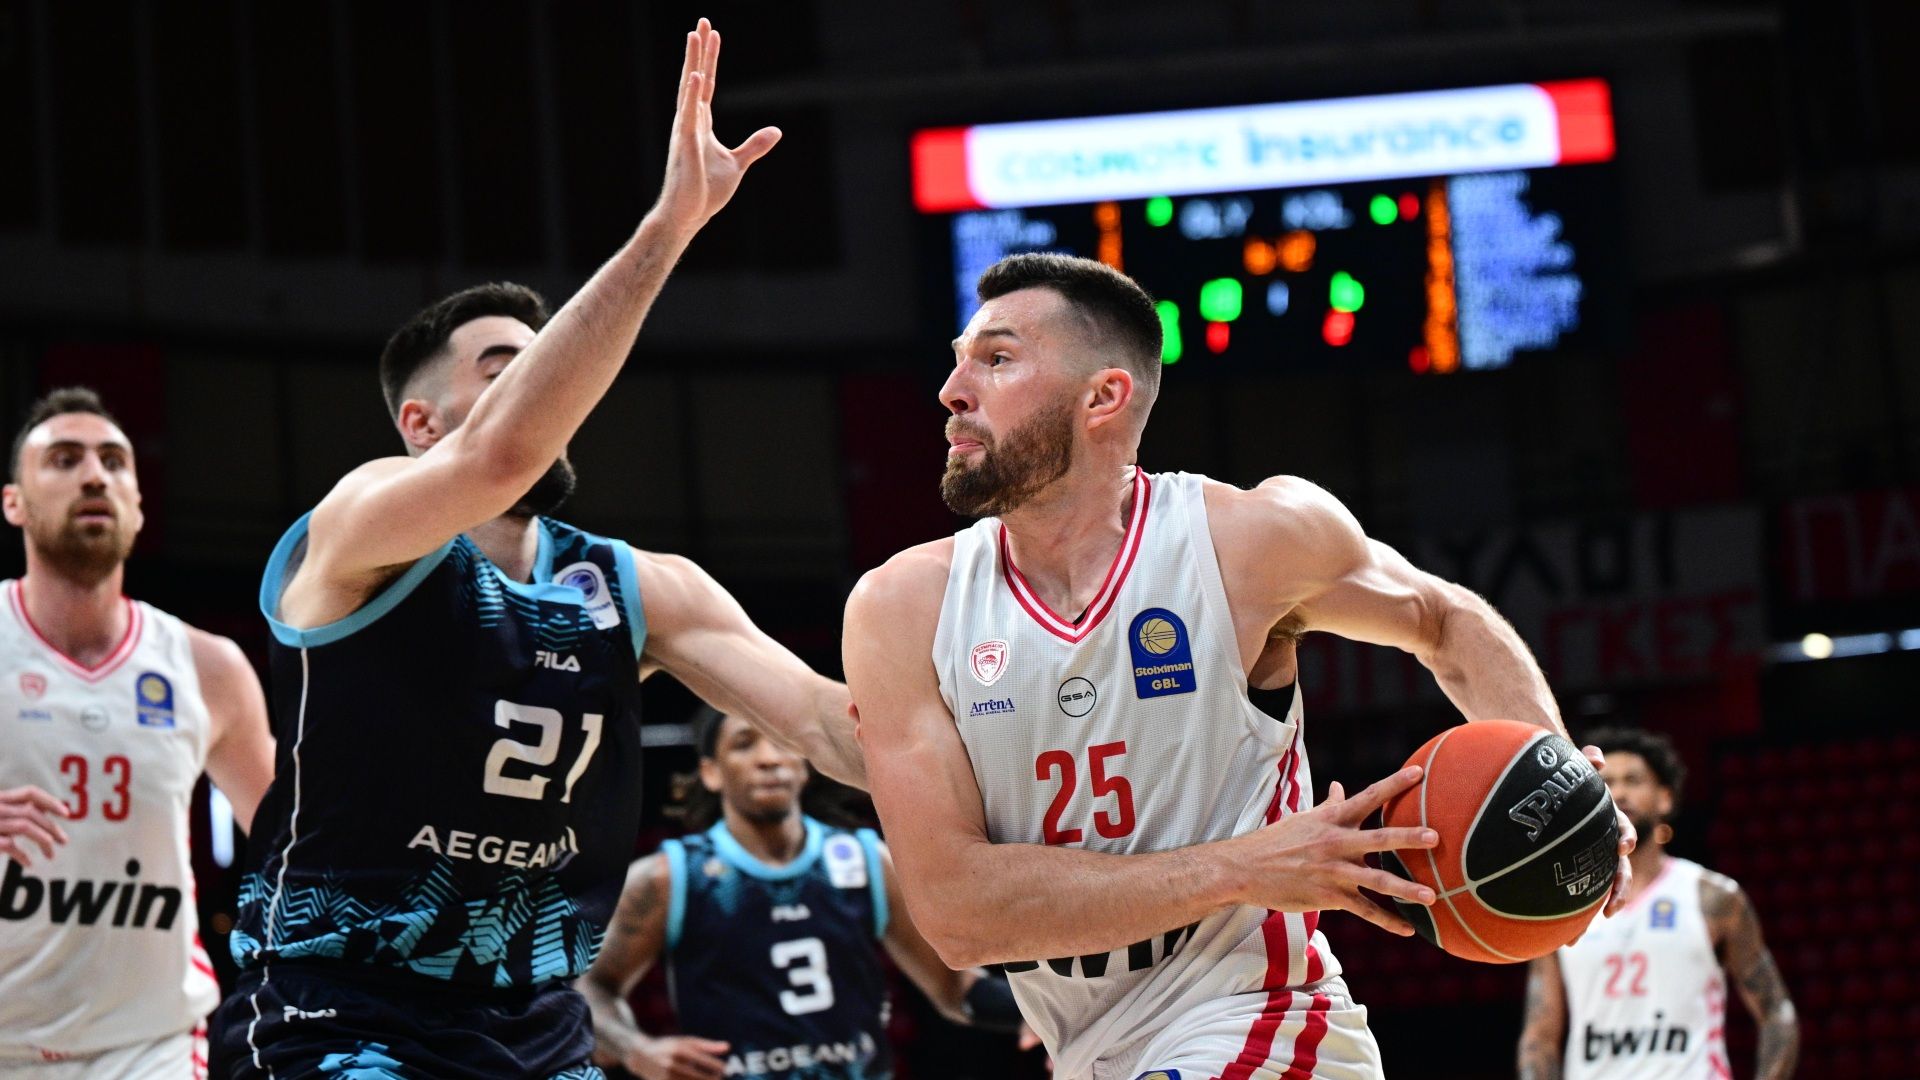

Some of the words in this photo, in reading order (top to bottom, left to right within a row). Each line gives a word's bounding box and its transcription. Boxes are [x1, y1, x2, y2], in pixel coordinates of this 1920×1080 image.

[535, 650, 581, 672] FILA
[1135, 662, 1193, 677] Stoiximan
[1151, 677, 1180, 690] GBL
[1061, 690, 1094, 702] GSA
[483, 699, 604, 803] 21
[59, 754, 132, 822] 33
[1035, 740, 1136, 846] 25
[0, 857, 182, 932] bwin
[770, 937, 834, 1016] 3
[1602, 950, 1649, 999] 22
